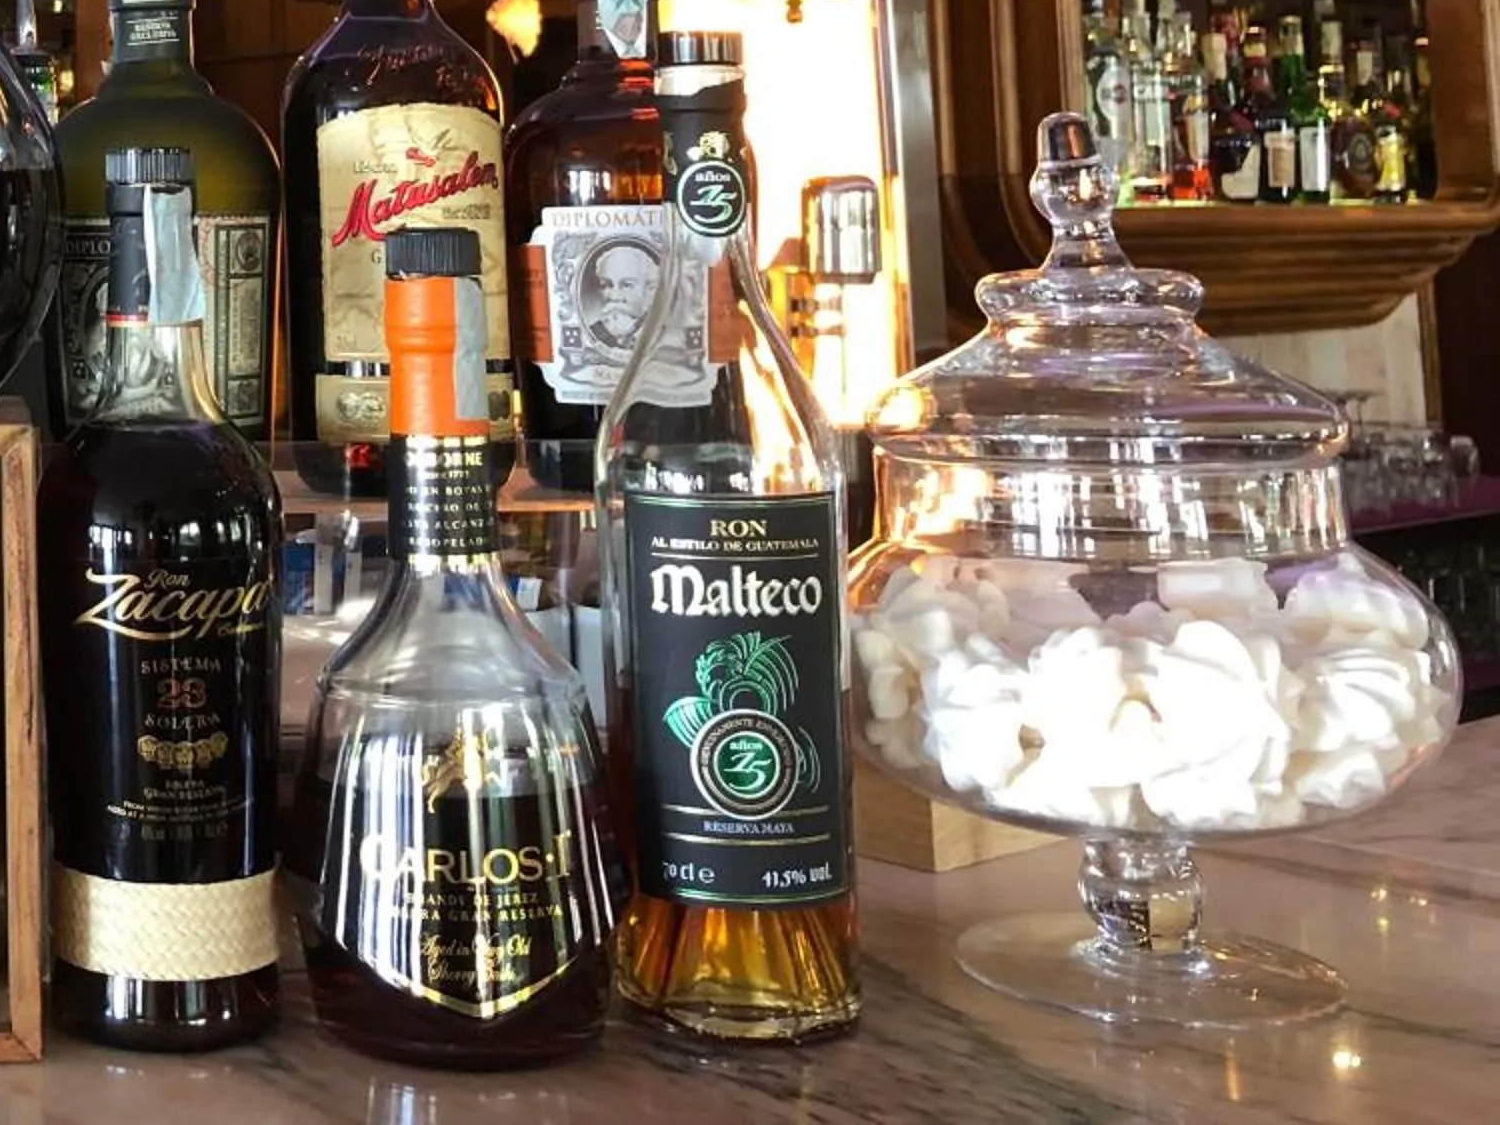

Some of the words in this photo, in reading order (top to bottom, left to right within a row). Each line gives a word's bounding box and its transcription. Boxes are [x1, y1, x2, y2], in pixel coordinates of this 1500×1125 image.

[709, 519, 767, 538] RON
[651, 536, 668, 548] AL
[723, 539, 743, 552] DE
[745, 537, 820, 553] GUATEMALA
[148, 568, 191, 590] Ron
[650, 563, 822, 618] Malteco
[75, 567, 269, 640] Zacapa
[155, 676, 207, 710] 23
[723, 752, 773, 790] 15
[703, 819, 760, 834] RESERVA
[761, 823, 796, 834] MAYA
